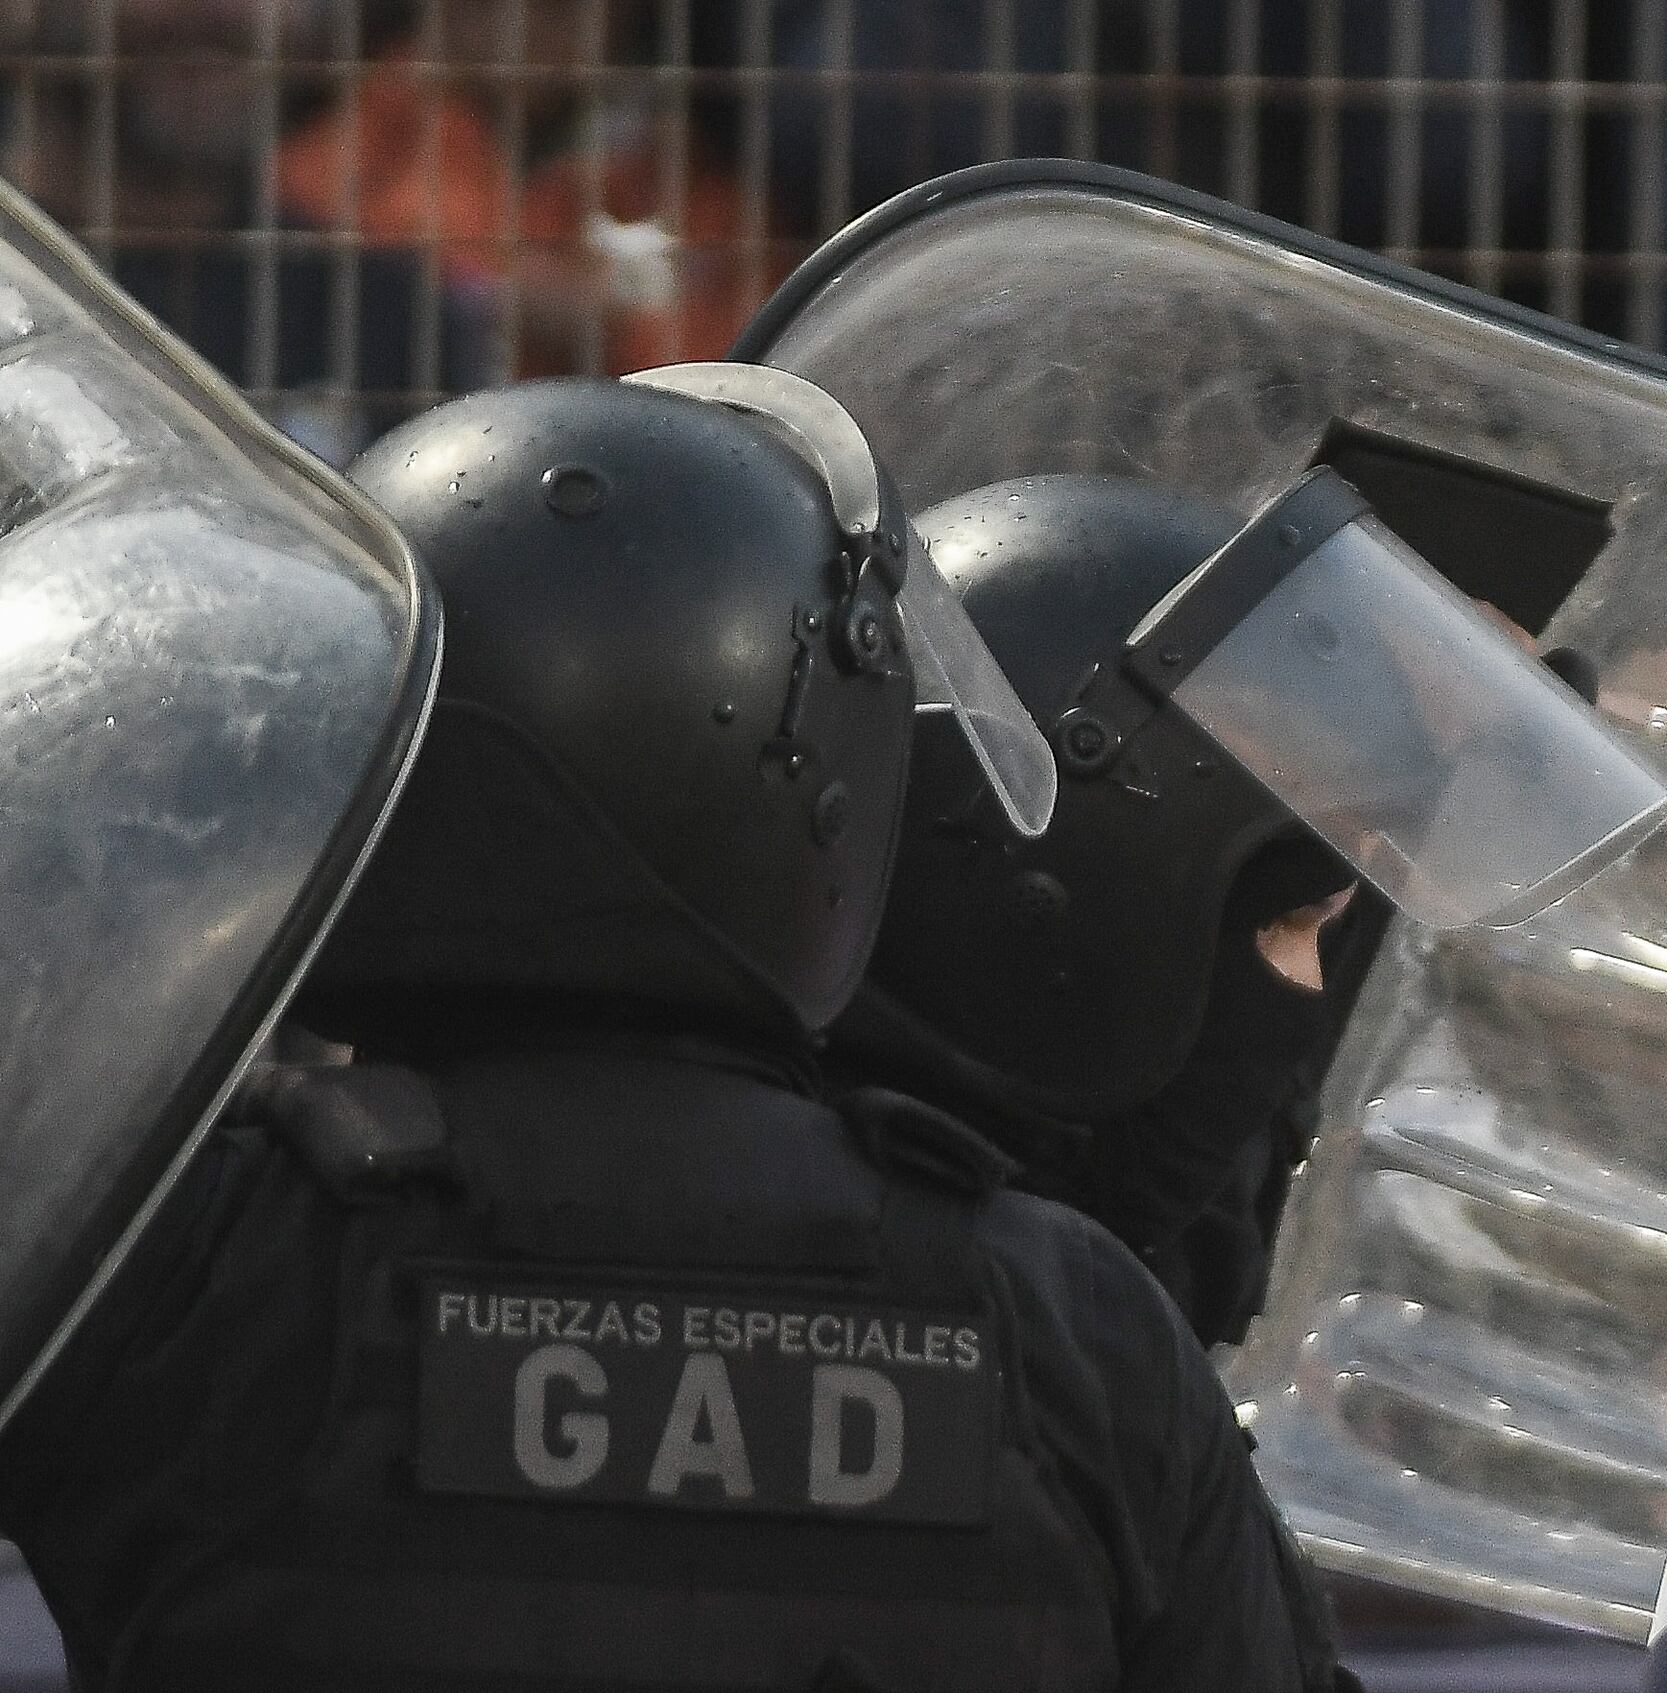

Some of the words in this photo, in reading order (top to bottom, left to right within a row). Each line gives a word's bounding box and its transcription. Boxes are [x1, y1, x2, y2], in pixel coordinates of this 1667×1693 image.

[438, 1293, 662, 1345] FUERZAS
[682, 1306, 982, 1370] ESPECIALES
[513, 1343, 906, 1506] GAD
